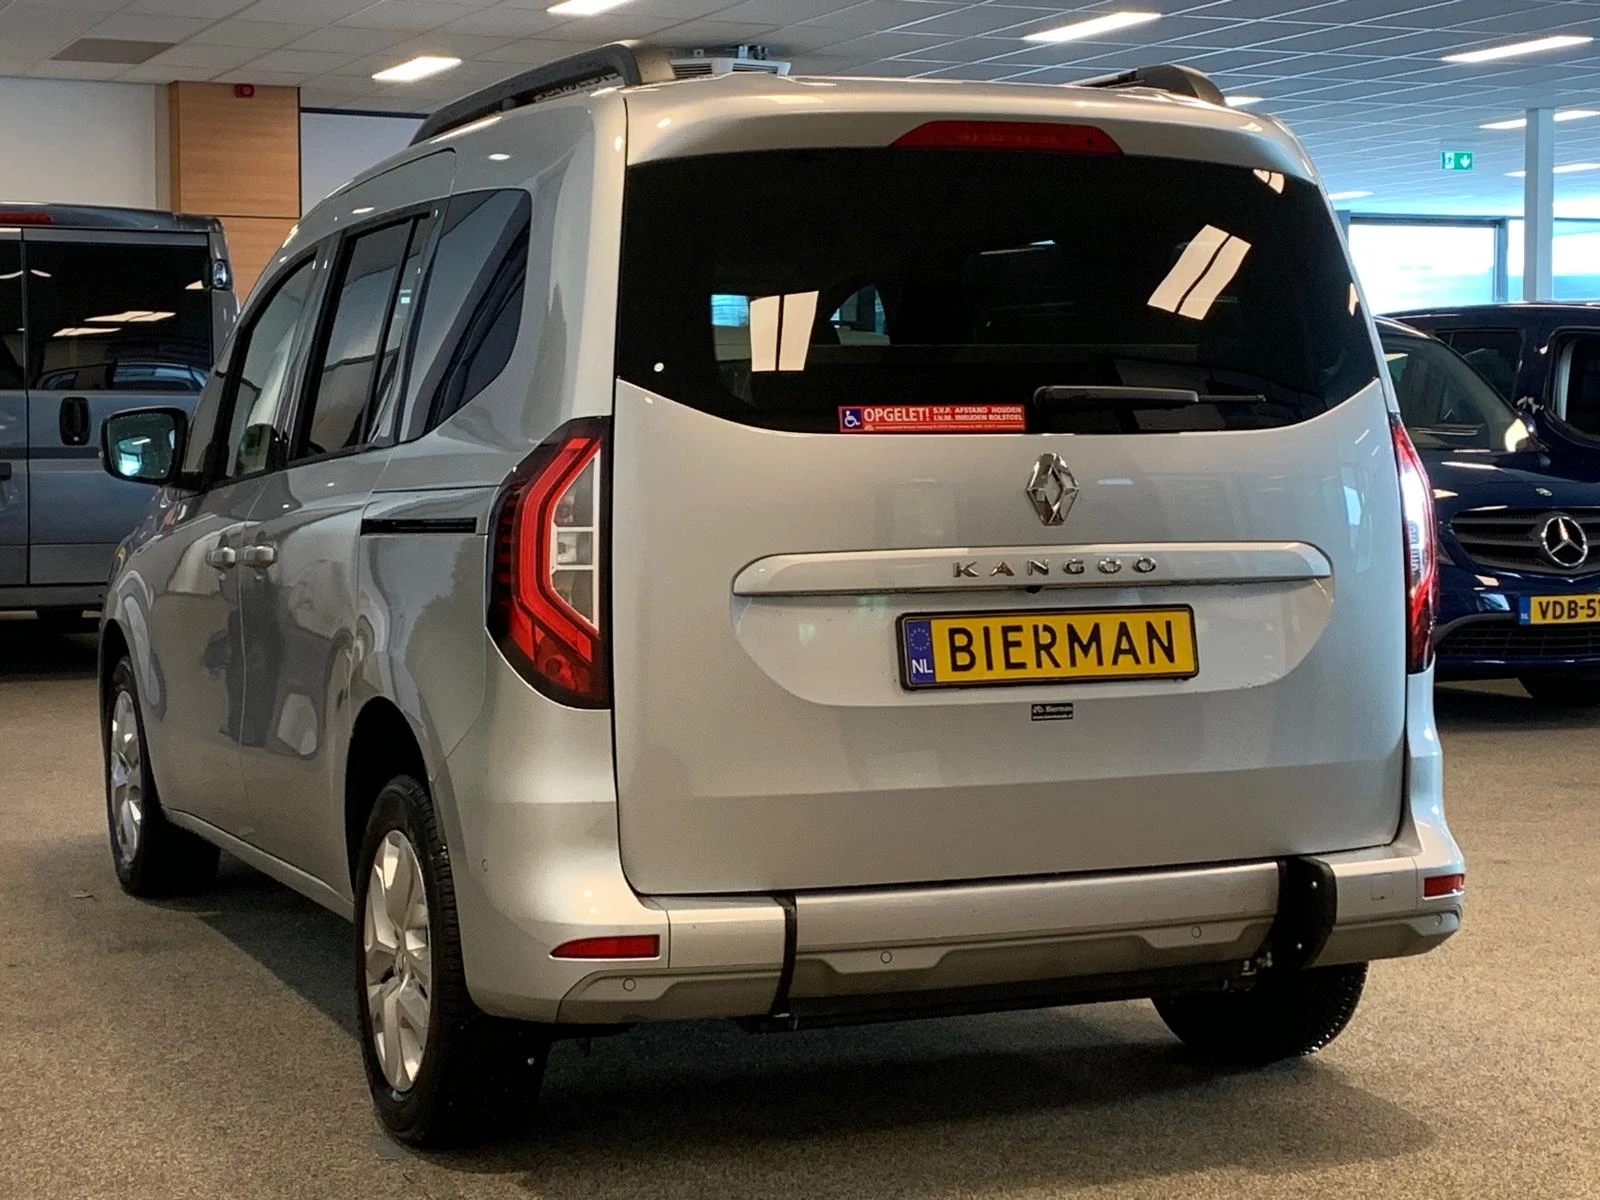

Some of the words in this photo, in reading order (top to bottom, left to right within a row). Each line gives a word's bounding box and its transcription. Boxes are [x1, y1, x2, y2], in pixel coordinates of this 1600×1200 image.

[863, 407, 930, 422] OPGELET!
[954, 406, 988, 414] AFSTAND
[991, 406, 1022, 414] HOUDEN
[988, 413, 1023, 421] ROLSTOEL
[952, 556, 1157, 578] KANGOO
[1538, 598, 1600, 620] VDB-5
[911, 658, 934, 674] NL
[947, 620, 1176, 673] BIERMAN
